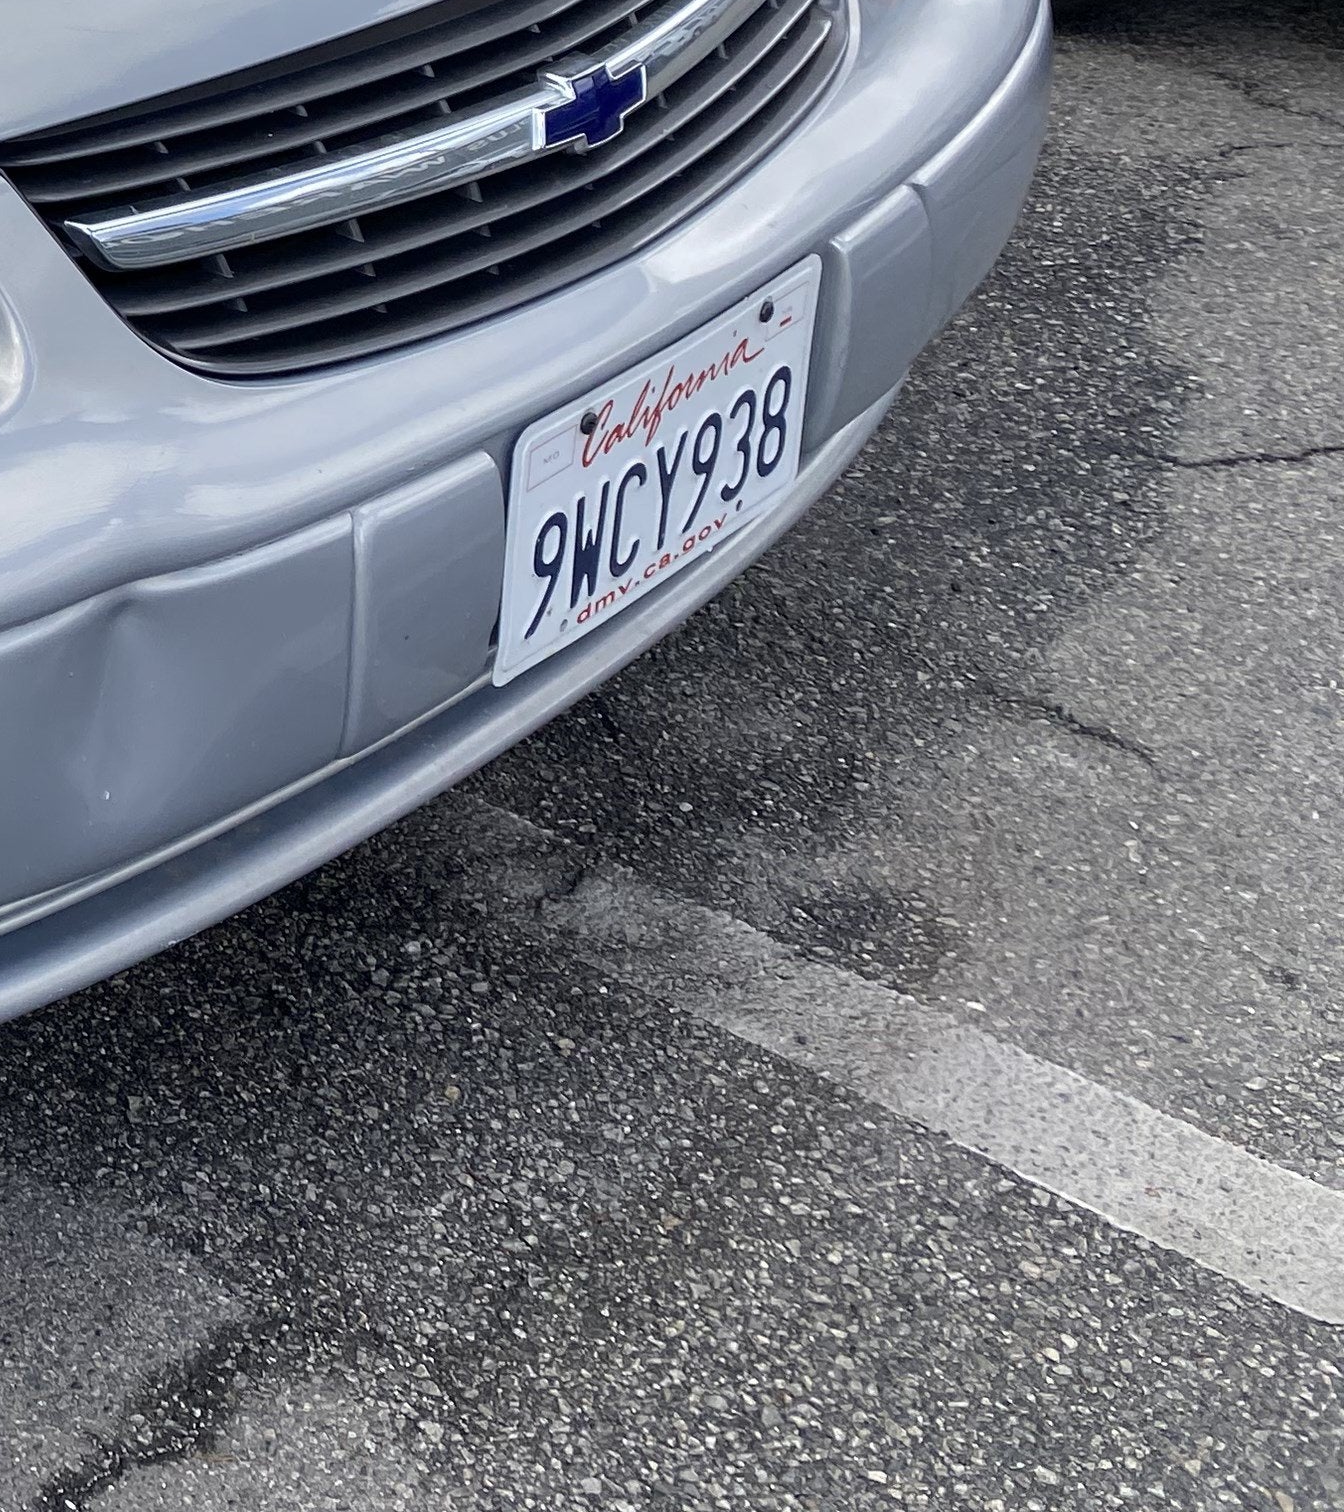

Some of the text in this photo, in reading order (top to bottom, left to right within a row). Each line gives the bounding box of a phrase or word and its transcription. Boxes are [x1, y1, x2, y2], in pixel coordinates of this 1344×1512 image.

[581, 336, 765, 469] California
[522, 364, 792, 640] 9WCY938
[576, 512, 728, 625] dmv.ca.gov
